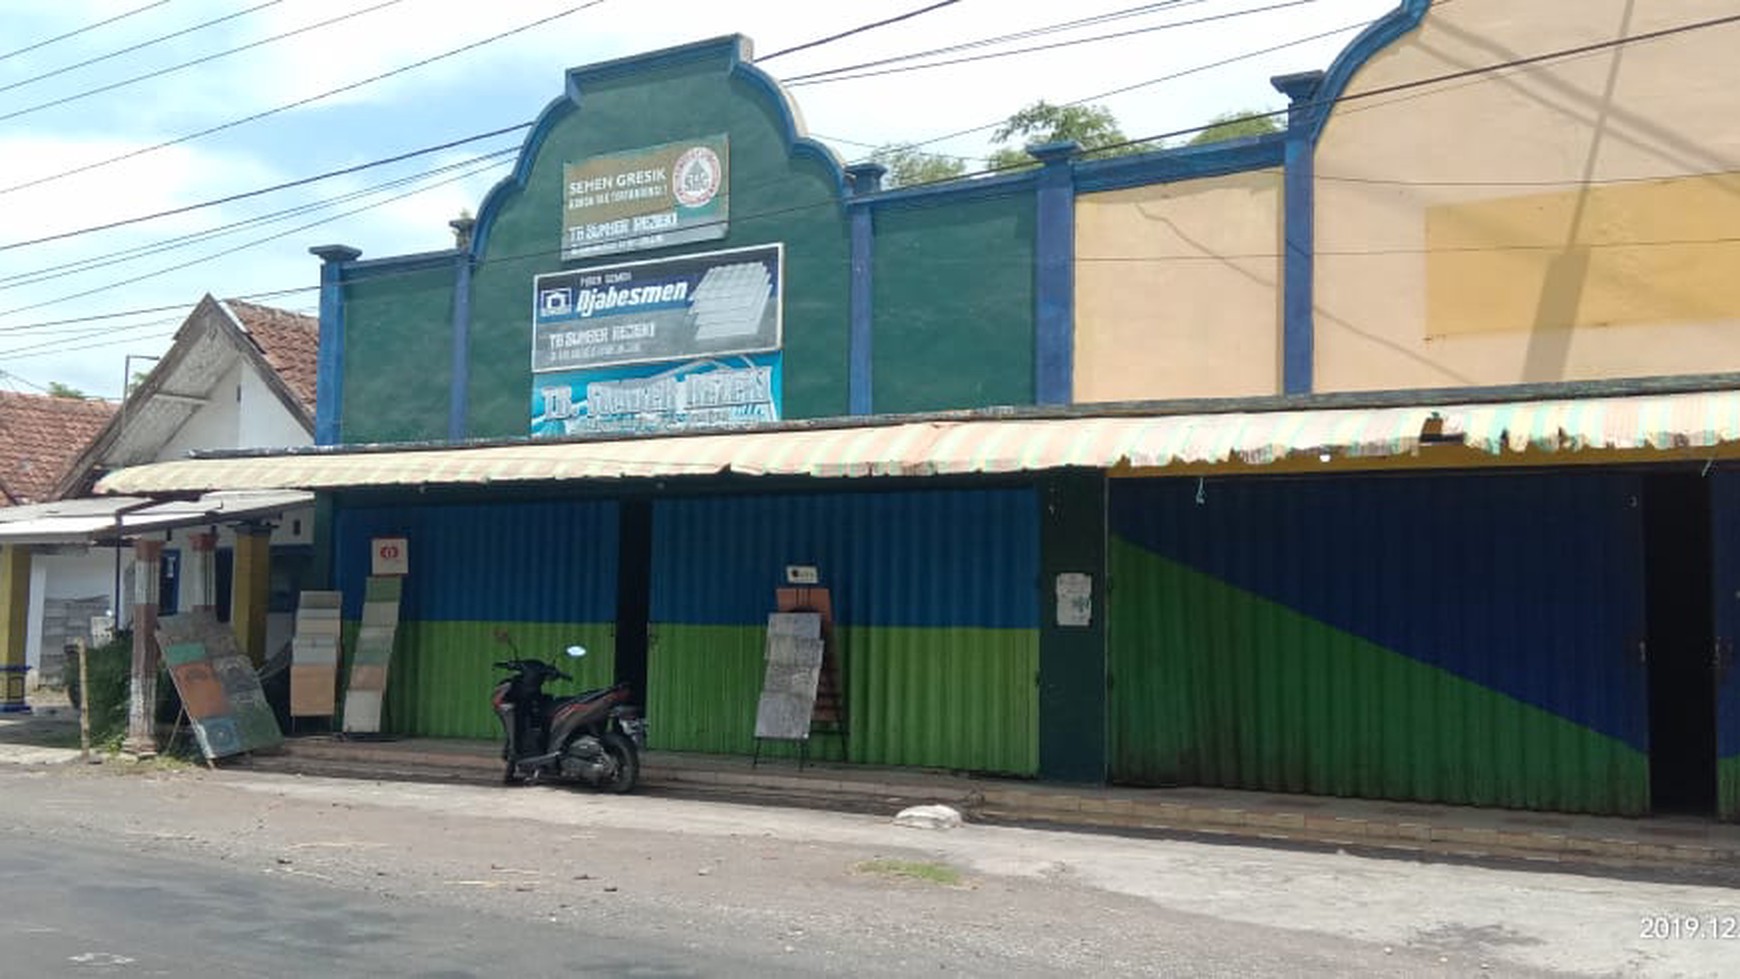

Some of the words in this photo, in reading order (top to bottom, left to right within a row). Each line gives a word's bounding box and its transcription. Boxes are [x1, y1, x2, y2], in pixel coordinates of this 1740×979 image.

[569, 177, 613, 195] SEMEN
[616, 168, 667, 187] GRESIK
[577, 281, 687, 317] Djabesmen
